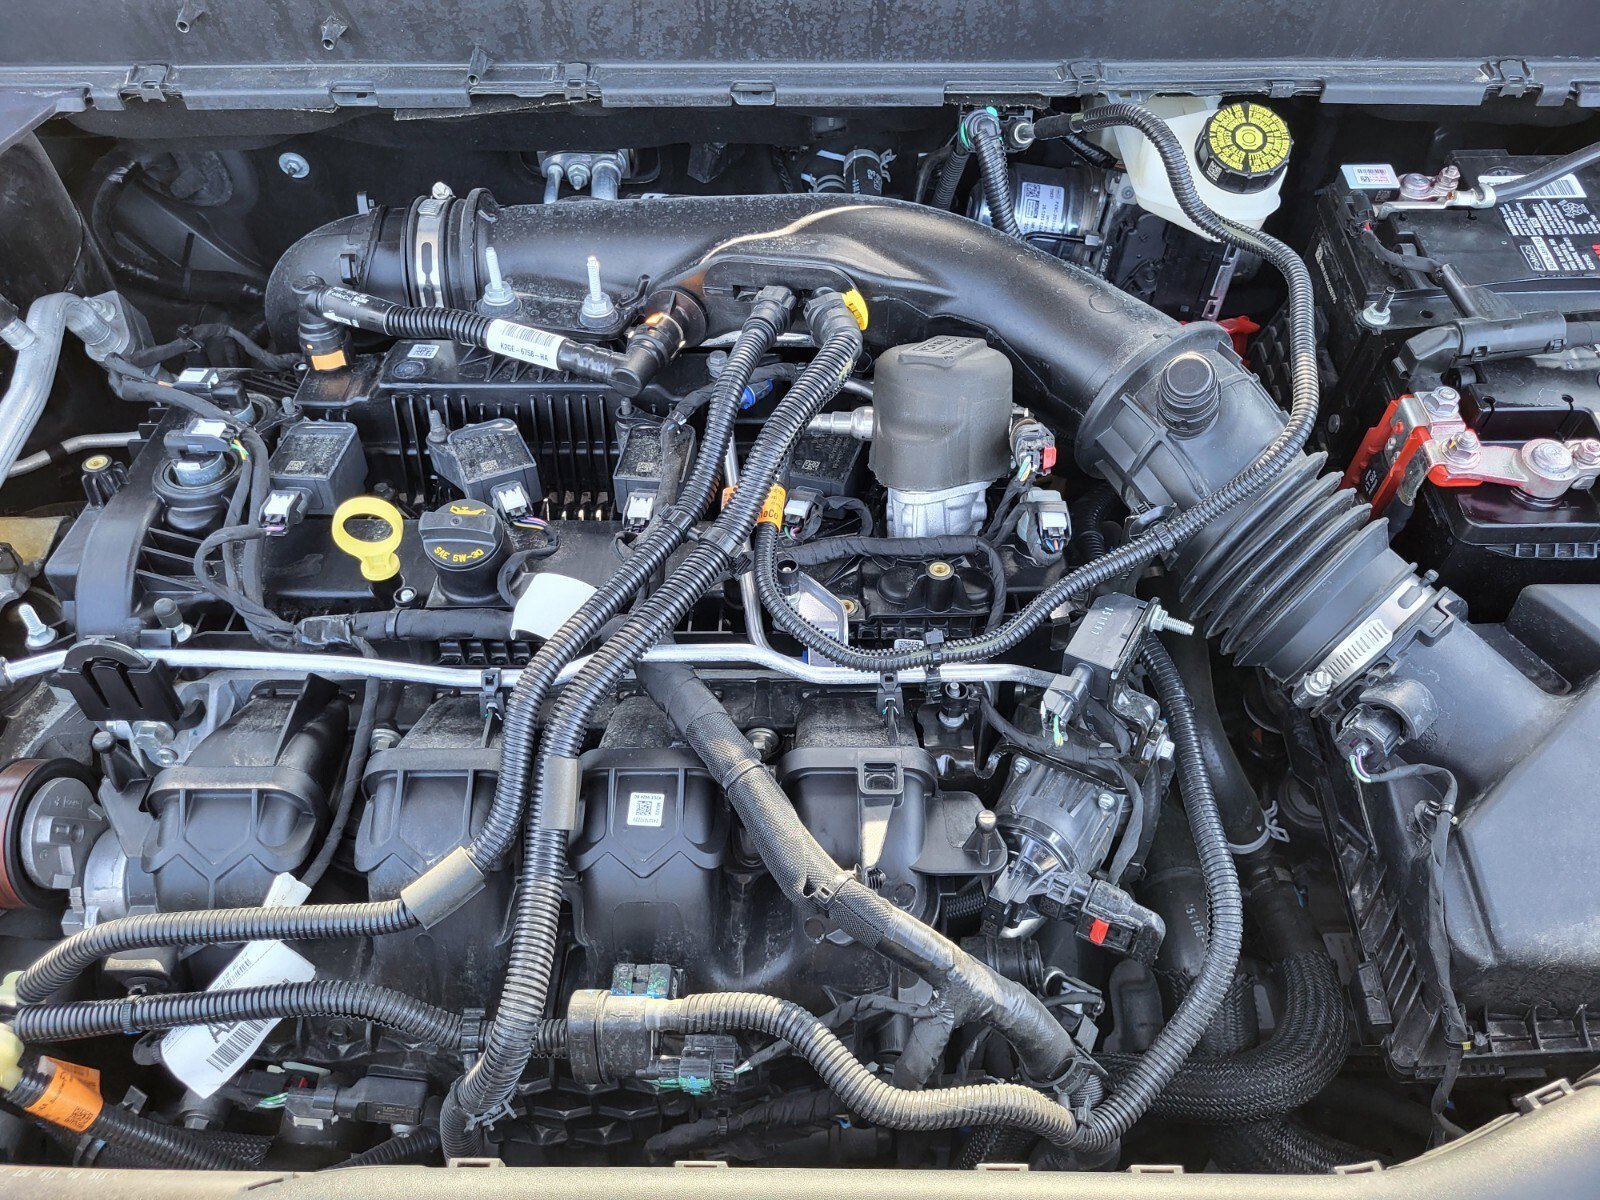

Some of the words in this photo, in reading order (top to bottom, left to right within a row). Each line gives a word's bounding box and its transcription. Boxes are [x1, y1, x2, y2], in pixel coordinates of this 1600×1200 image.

[1525, 245, 1542, 270] FoMoCo
[434, 546, 450, 560] SAE
[452, 548, 484, 562] 5W-30
